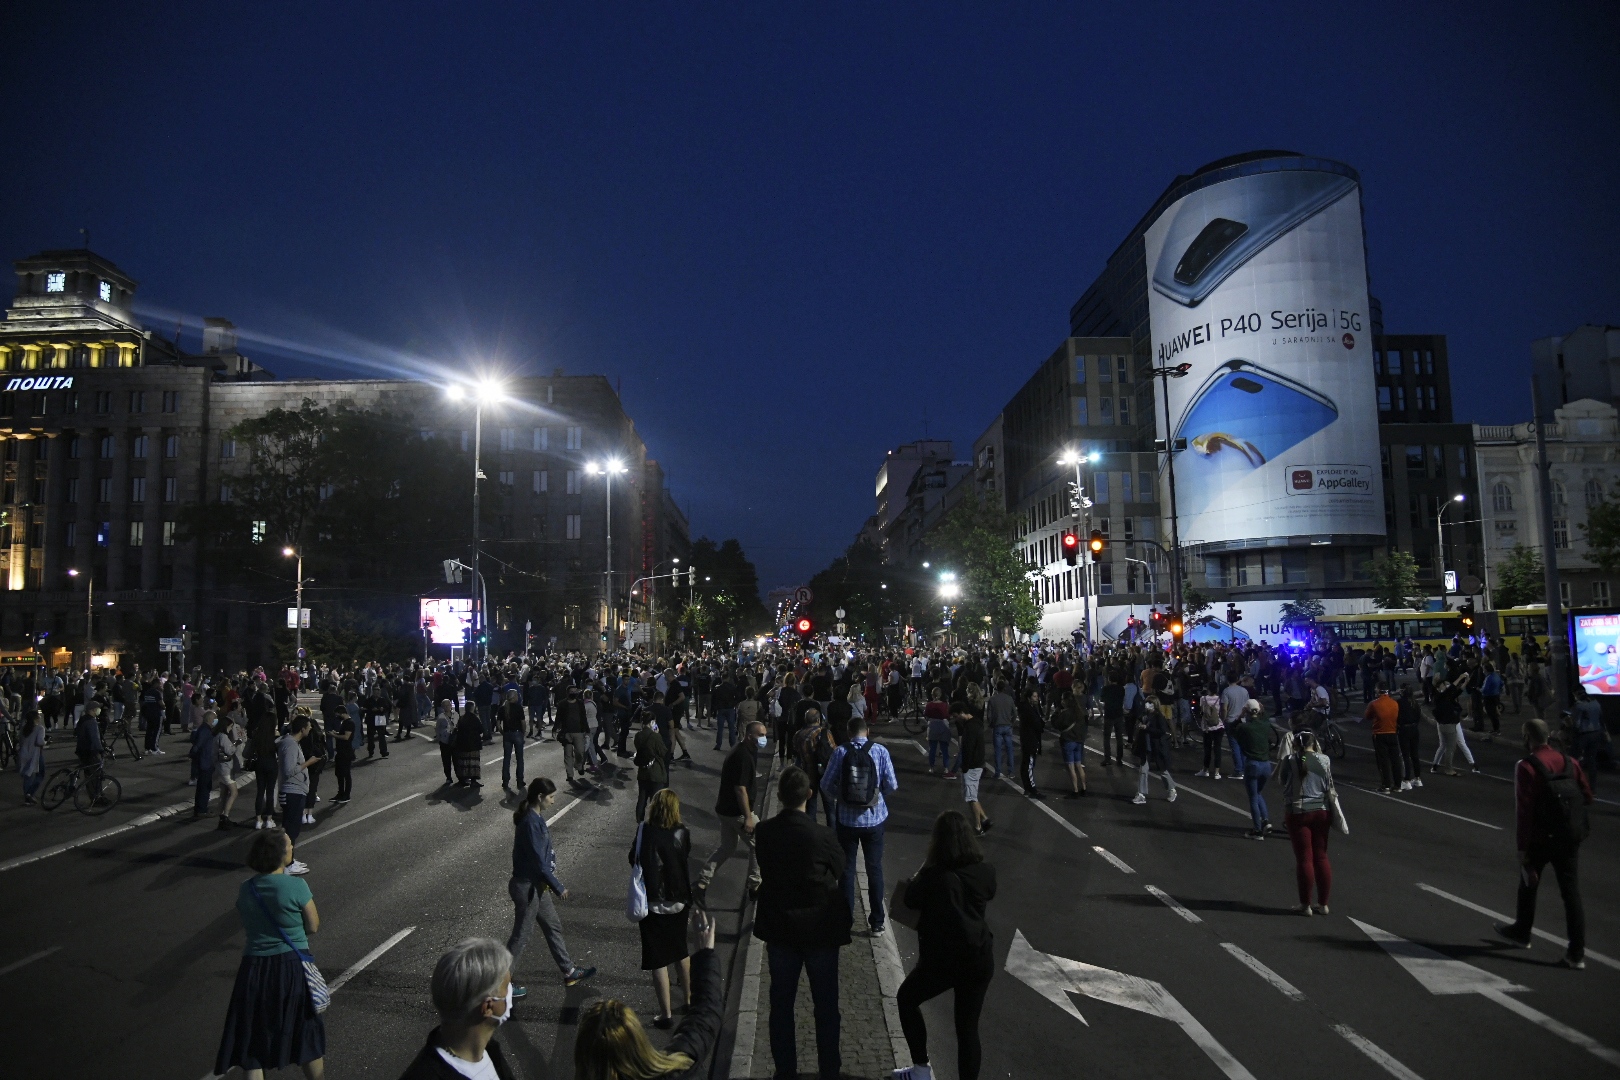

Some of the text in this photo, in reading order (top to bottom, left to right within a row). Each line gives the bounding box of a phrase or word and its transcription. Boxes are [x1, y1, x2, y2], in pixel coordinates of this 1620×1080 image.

[1158, 308, 1361, 366] HUAWEI P40 Serija 5G
[6, 376, 74, 391] ПОШТА
[1318, 477, 1369, 490] AppGallery
